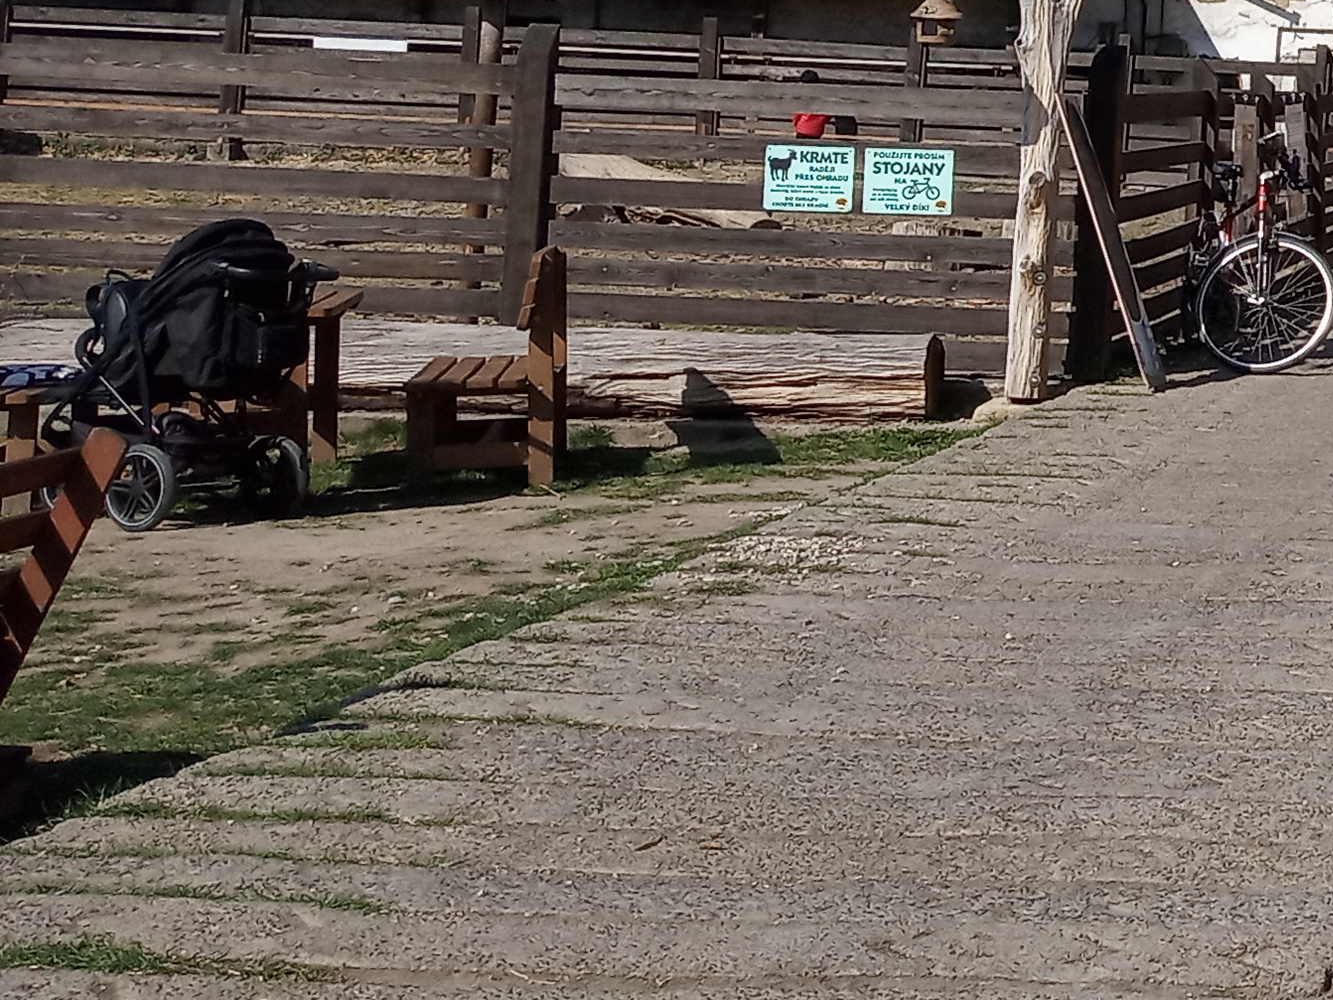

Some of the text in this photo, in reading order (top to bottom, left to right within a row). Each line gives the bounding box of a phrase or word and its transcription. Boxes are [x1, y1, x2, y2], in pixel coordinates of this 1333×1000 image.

[800, 150, 849, 164] KRMTE
[874, 151, 945, 161] POUŽIJTE PROSÍM
[809, 165, 835, 173] RADĚJI
[873, 161, 946, 176] STOJANY
[795, 172, 814, 181] PŘES
[894, 177, 908, 185] NA
